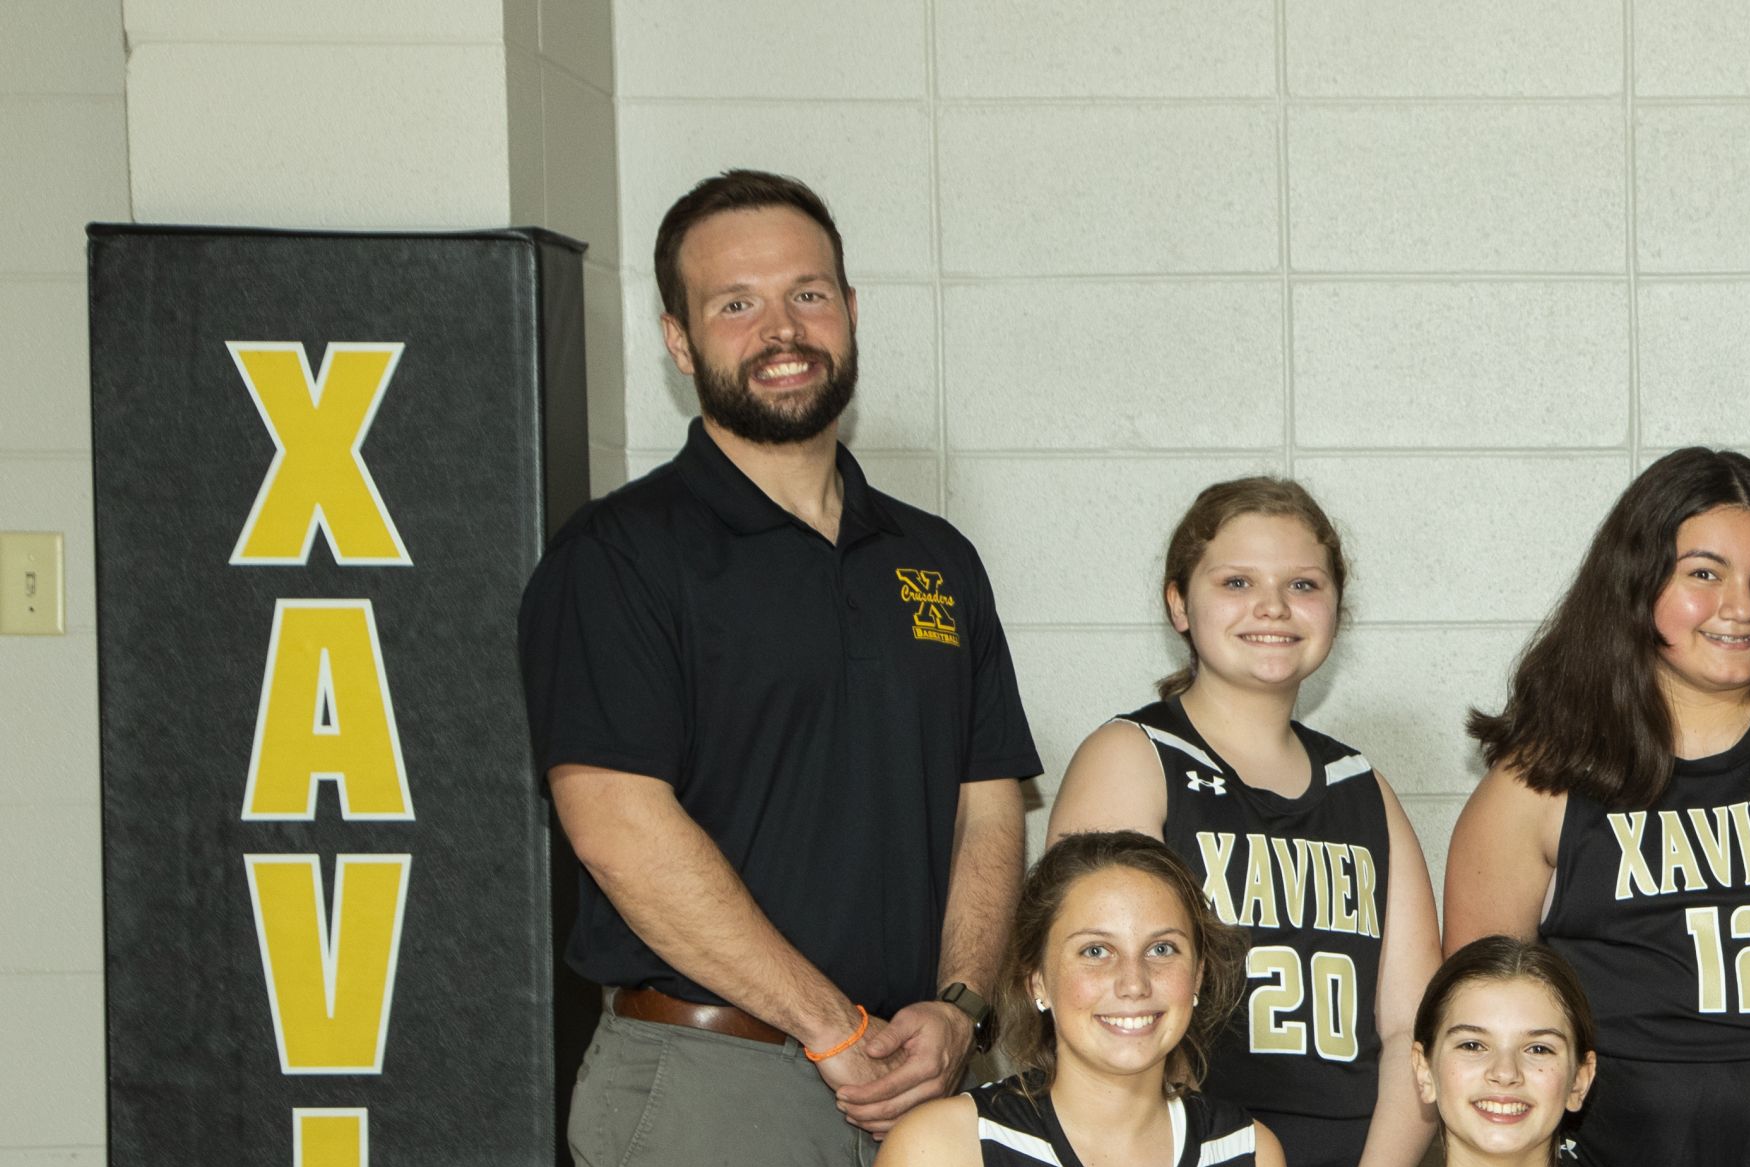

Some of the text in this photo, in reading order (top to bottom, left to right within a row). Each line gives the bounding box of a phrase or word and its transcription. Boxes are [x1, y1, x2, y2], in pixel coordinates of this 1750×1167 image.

[901, 585, 954, 606] Crusaders
[1196, 832, 1380, 938] XAVIER
[1246, 945, 1358, 1062] 20
